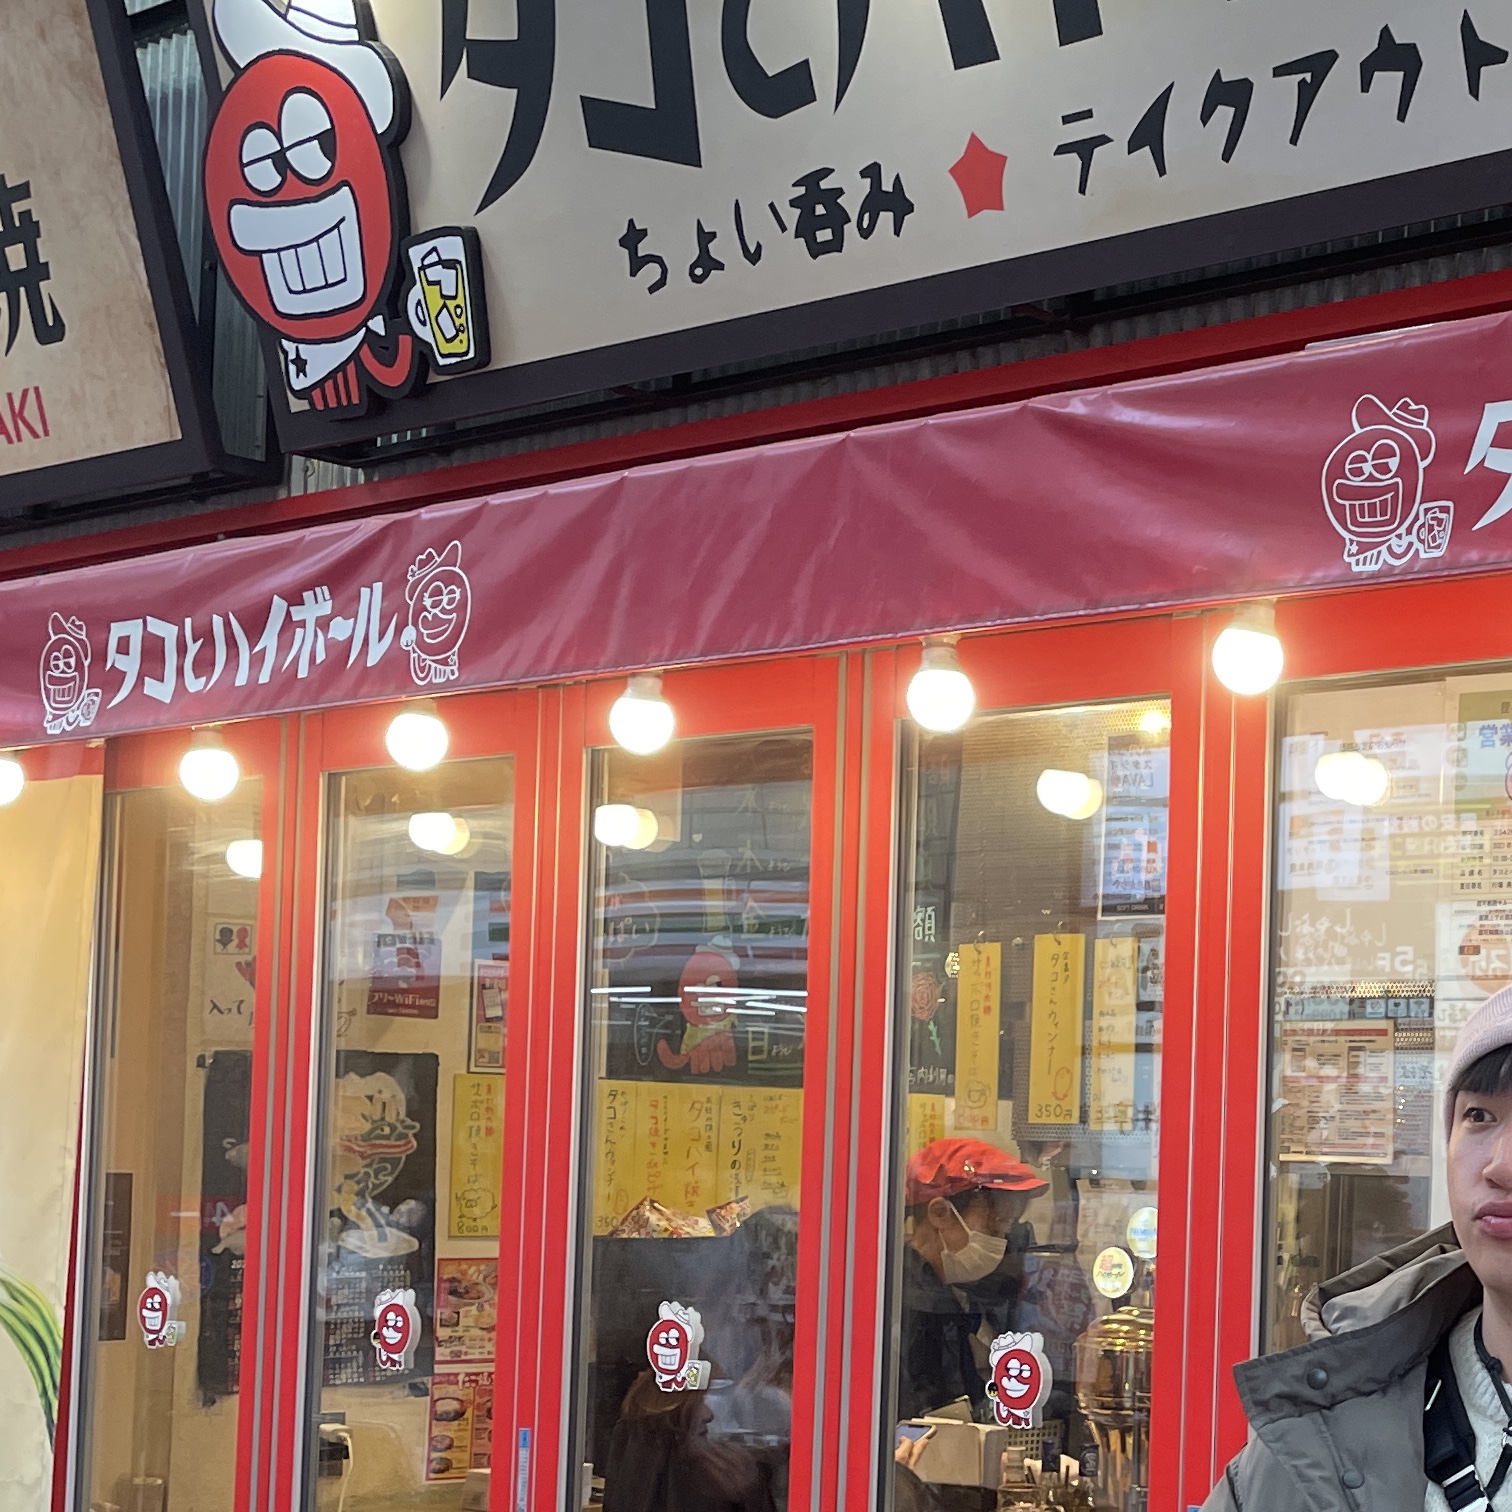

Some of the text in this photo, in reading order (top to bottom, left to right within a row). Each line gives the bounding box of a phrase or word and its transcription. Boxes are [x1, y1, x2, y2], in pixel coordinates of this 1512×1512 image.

[618, 8, 1510, 296] ちょい呑み テイクアウト
[105, 582, 401, 709] タコとハイボール
